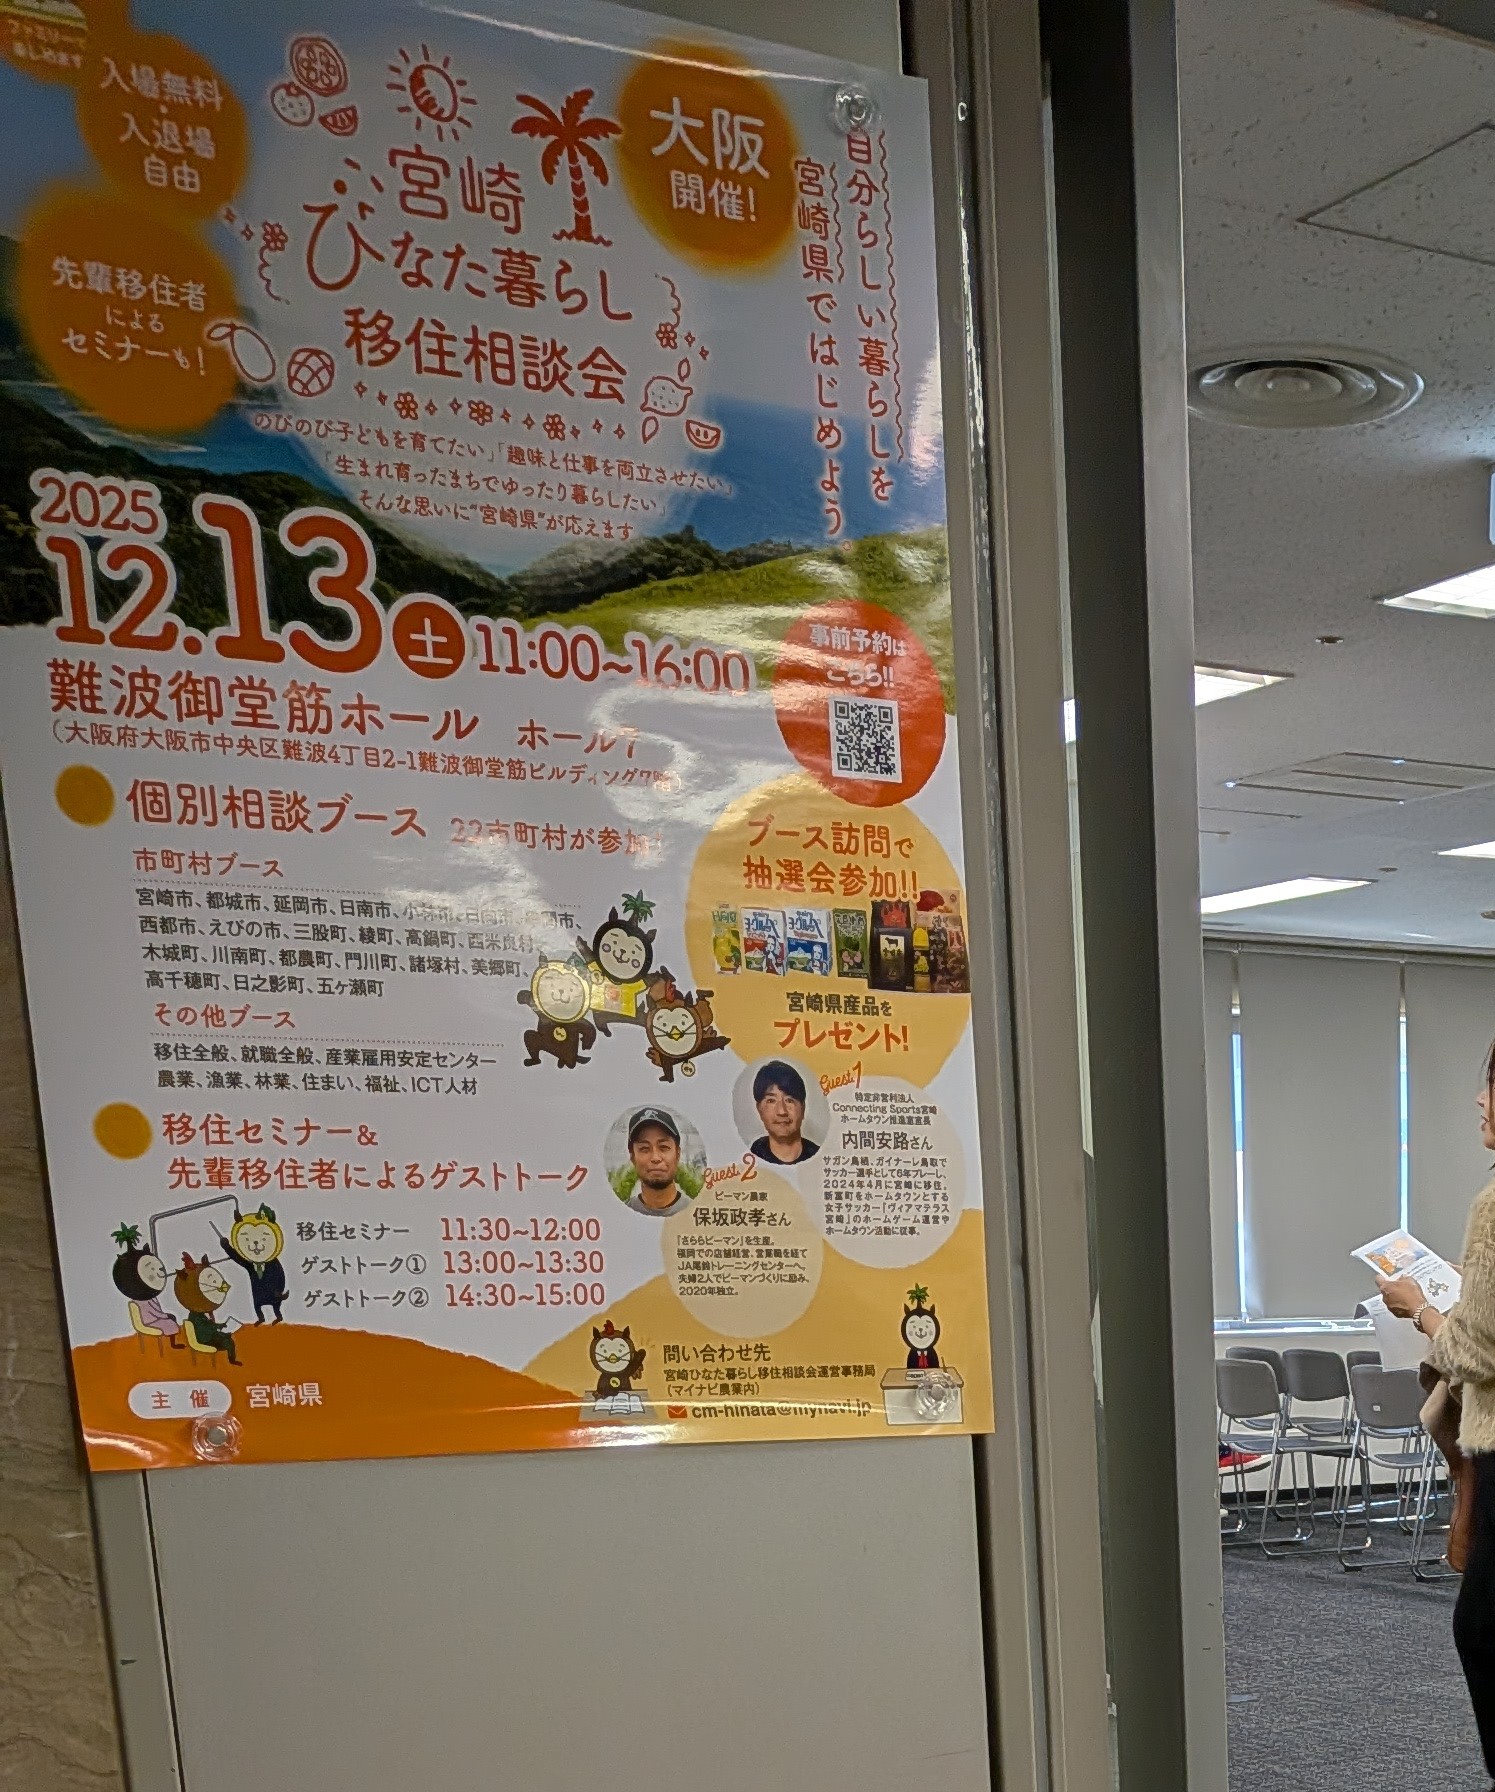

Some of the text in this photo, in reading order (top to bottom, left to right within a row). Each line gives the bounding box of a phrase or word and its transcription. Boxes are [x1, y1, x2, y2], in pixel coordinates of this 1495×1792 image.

[100, 56, 223, 111] 入場無料
[118, 112, 216, 160] 入退場
[649, 96, 770, 180] 大阪
[142, 155, 201, 194] 自由
[387, 143, 527, 236] 宮崎
[669, 169, 758, 223] 開催!
[51, 255, 206, 313] 先輩移住者
[105, 305, 165, 334] による
[846, 130, 895, 502] 自分らしい暮らしを
[62, 327, 208, 377] セミナーも!
[343, 306, 628, 405] 移住相談会
[794, 156, 844, 536] 宮崎県ではじめよう
[38, 476, 160, 535] 2025
[45, 501, 384, 675] 12.13
[808, 622, 908, 657] 事前予約は
[46, 658, 639, 759] 難波御堂筋ホール ホール7
[126, 777, 428, 839] 個別相談ブース
[746, 812, 915, 860] ブース訪問で
[132, 847, 285, 879] 市町村ブース
[153, 1002, 297, 1030] その他ブース
[785, 990, 893, 1017] 宮崎県産品を
[773, 1019, 910, 1053] プレゼント!
[152, 1042, 497, 1070] 移住全般、就職全般、産業雇用安定センター
[832, 1102, 889, 1115] Connecting
[161, 1112, 380, 1147] 移住セミナー&
[842, 1130, 934, 1151] 内間安路さん
[166, 1155, 589, 1193] 先輩移住者によるゲストトーク
[741, 1152, 758, 1182] 2
[295, 1220, 411, 1243] 移住セミナー
[692, 1206, 792, 1228] 保坂政孝さん
[662, 1342, 773, 1365] 問い合わせ先
[663, 1363, 878, 1382] 宮崎ひなた暮らし移住相談会運営事務局
[245, 1381, 323, 1409] 宮崎県
